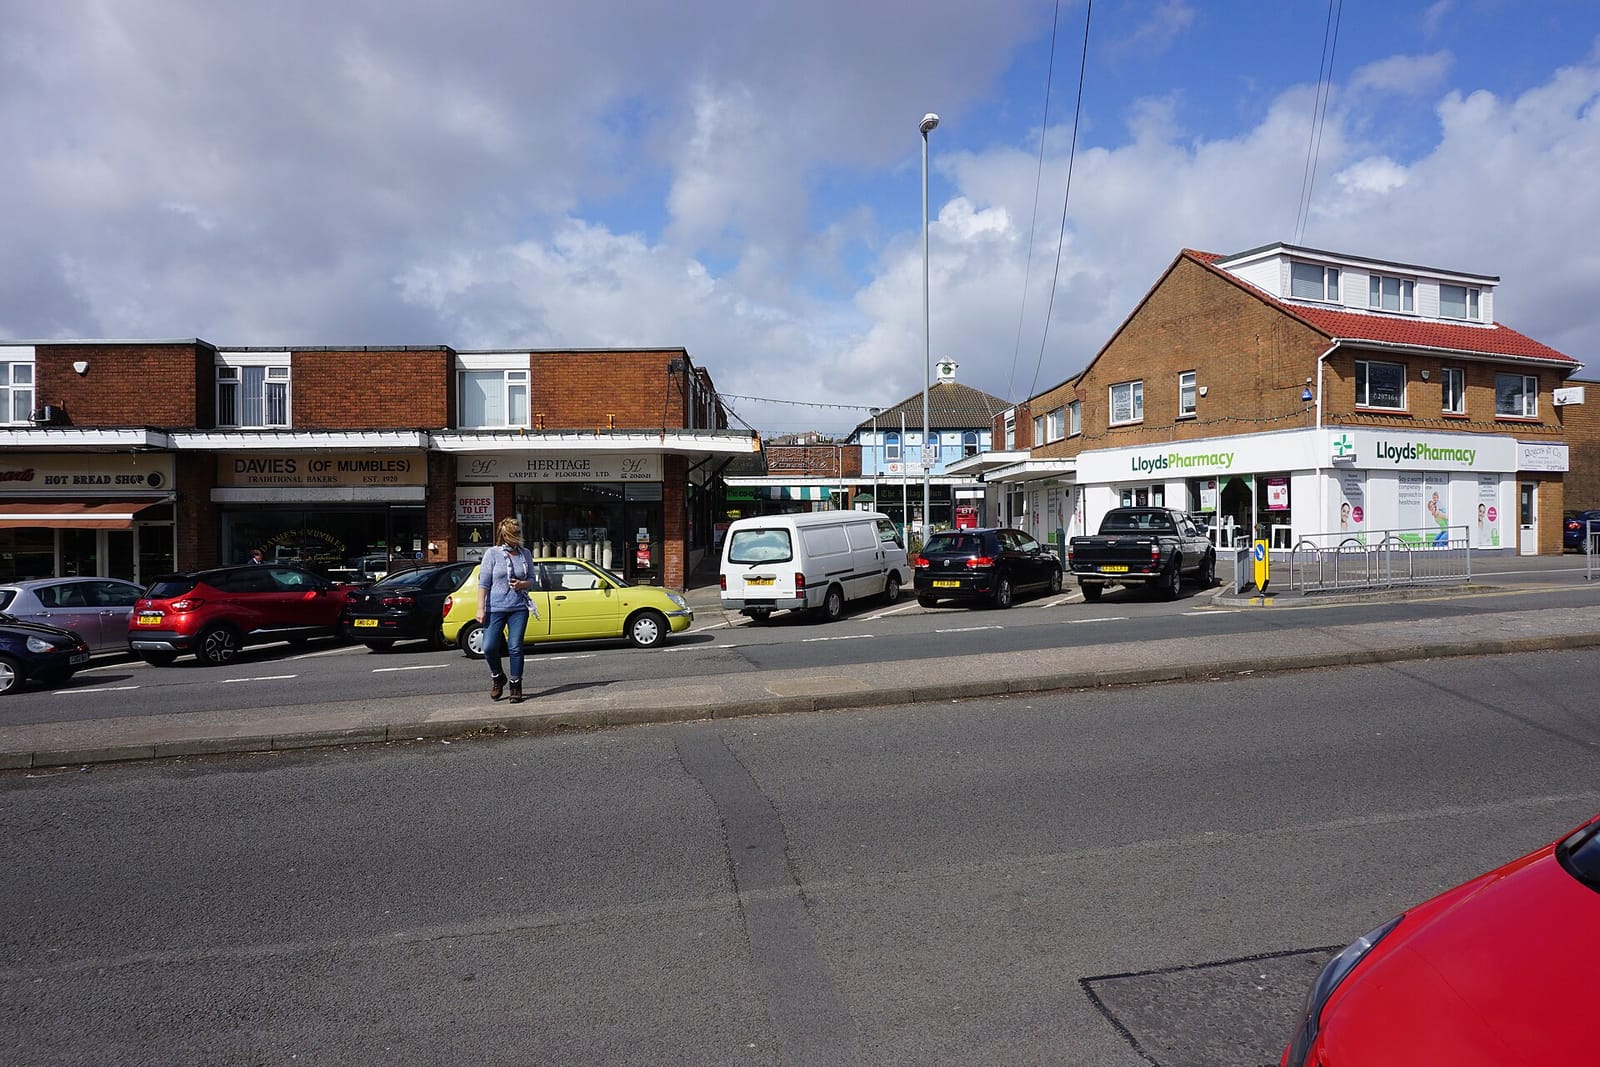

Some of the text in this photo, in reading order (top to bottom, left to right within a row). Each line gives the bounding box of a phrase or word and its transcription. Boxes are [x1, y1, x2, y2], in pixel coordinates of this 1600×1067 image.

[1377, 441, 1476, 466] LloydsPharmacy
[234, 458, 411, 474] DAVIES (OF MUMBLES)
[527, 460, 590, 470] HERITAGE
[1132, 452, 1234, 474] LloydsPharmacy
[45, 474, 145, 485] HOT BREAD SHOP
[248, 475, 303, 483] TRADITIONAL
[306, 475, 338, 483] BAKERS
[459, 498, 491, 506] OFFICES
